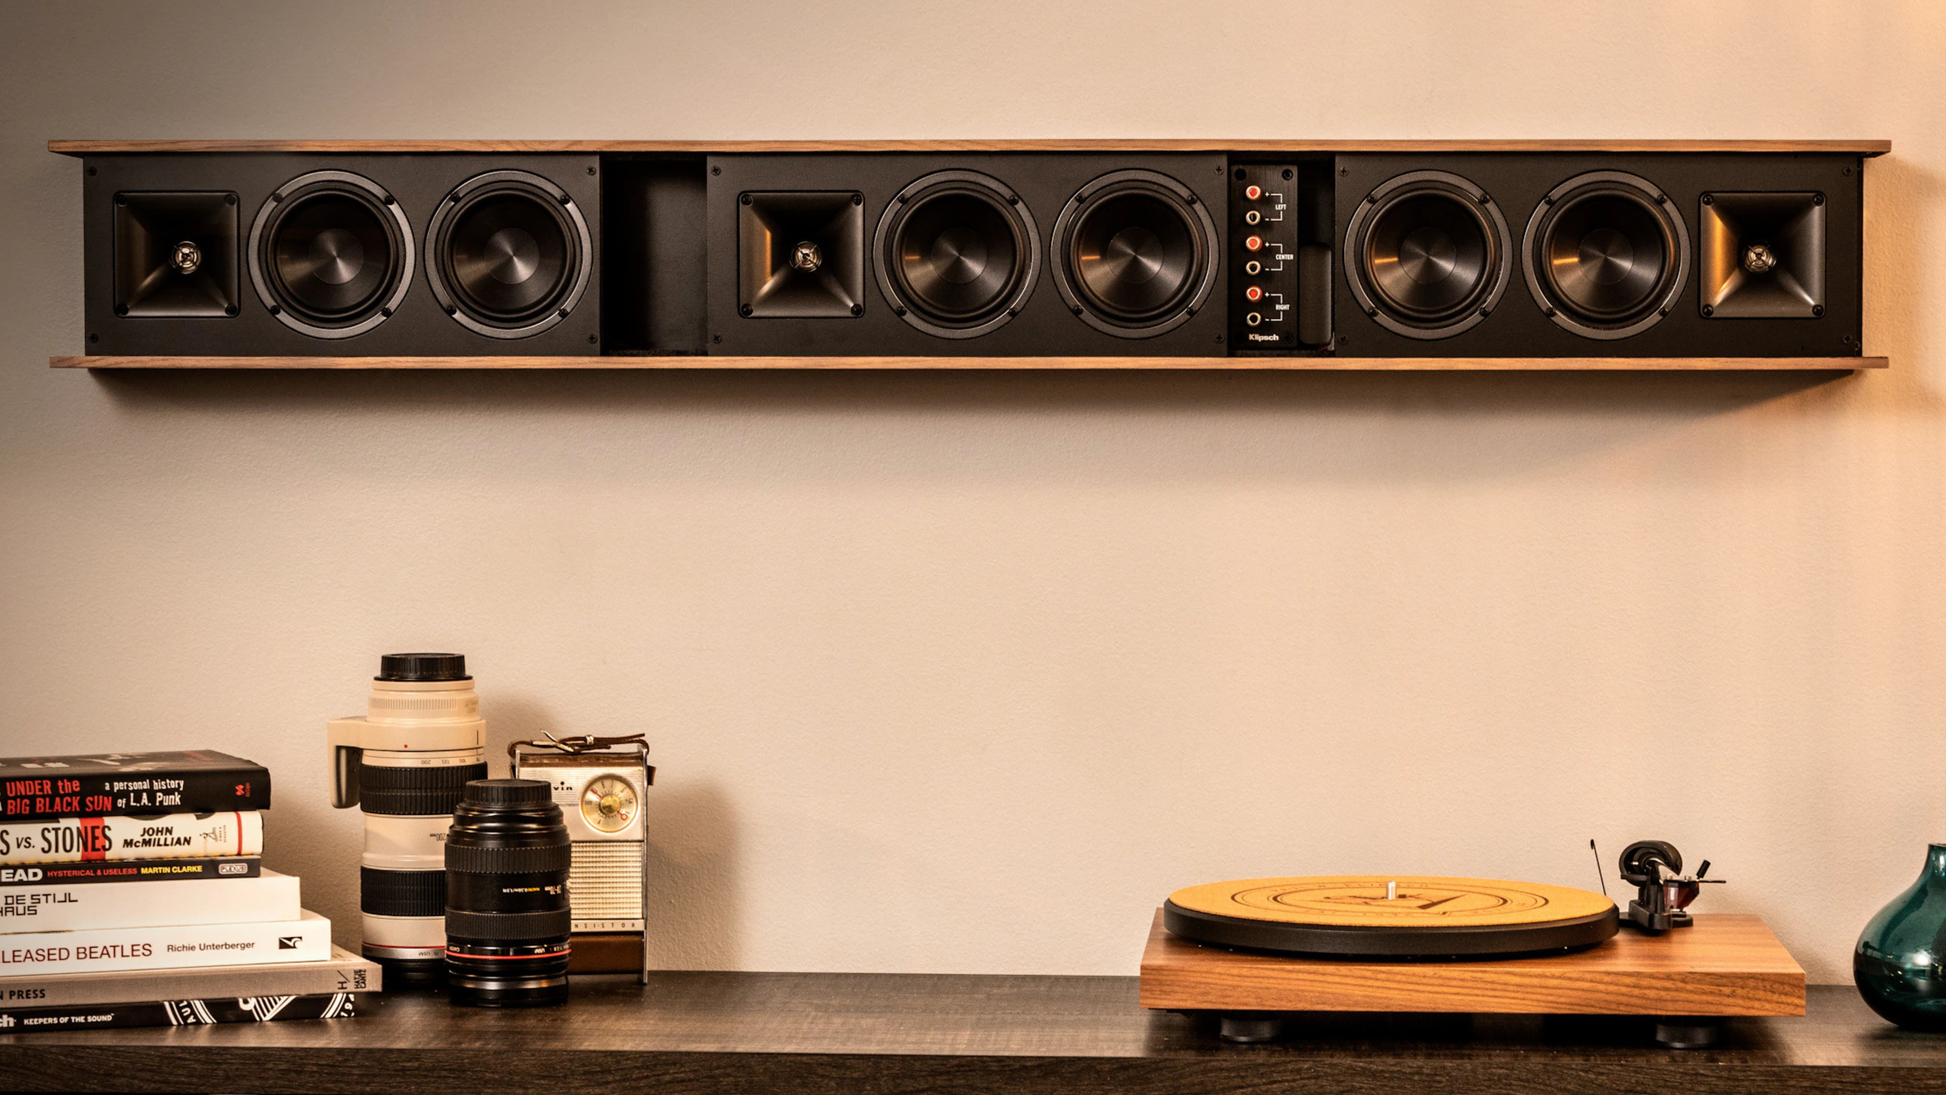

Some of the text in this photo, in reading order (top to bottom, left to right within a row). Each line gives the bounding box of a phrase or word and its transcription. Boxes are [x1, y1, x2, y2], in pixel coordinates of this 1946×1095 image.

[1248, 333, 1279, 342] Klipsch
[6, 779, 80, 797] UNDER the
[104, 779, 184, 792] a personal history
[7, 798, 30, 815] BIG
[35, 796, 80, 813] BLACK
[85, 795, 112, 812] SUN
[117, 791, 181, 808] of L.A. Punk
[140, 826, 173, 837] JOHN
[41, 825, 112, 854] STONES
[122, 836, 191, 848] McMILLIAN
[0, 868, 43, 883] EAD
[47, 869, 95, 878] HYSTERICAL
[103, 868, 138, 876] USELESS
[140, 865, 171, 874] MARTIN
[172, 865, 203, 874] CLARKE
[4, 894, 26, 905] DE
[1, 943, 152, 963] LEASED BEATLES
[167, 942, 255, 952] Richie Unterberger
[9, 989, 46, 1000] PRESS
[24, 1017, 58, 1025] KEEPERS
